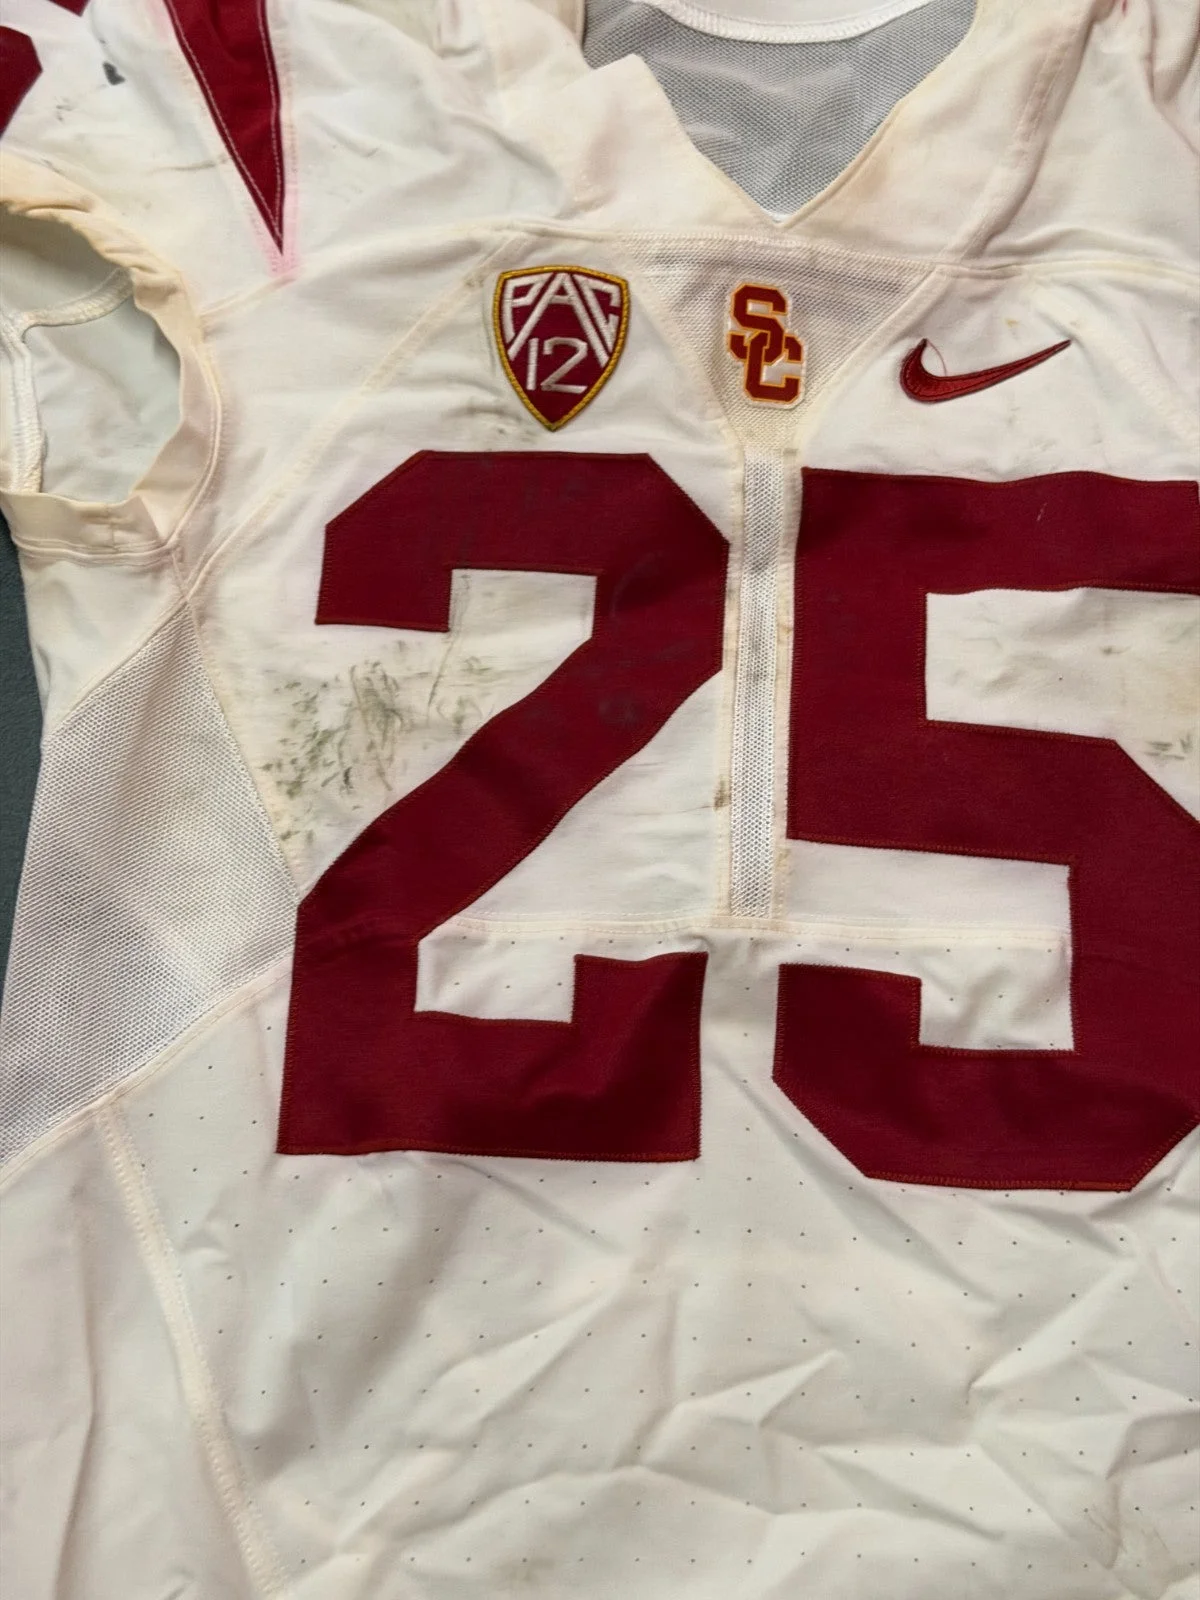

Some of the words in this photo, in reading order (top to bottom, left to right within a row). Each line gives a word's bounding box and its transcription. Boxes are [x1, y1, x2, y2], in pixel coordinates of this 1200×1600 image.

[503, 272, 620, 367] PAC
[526, 335, 588, 394] 12
[277, 450, 1200, 1192] 25
